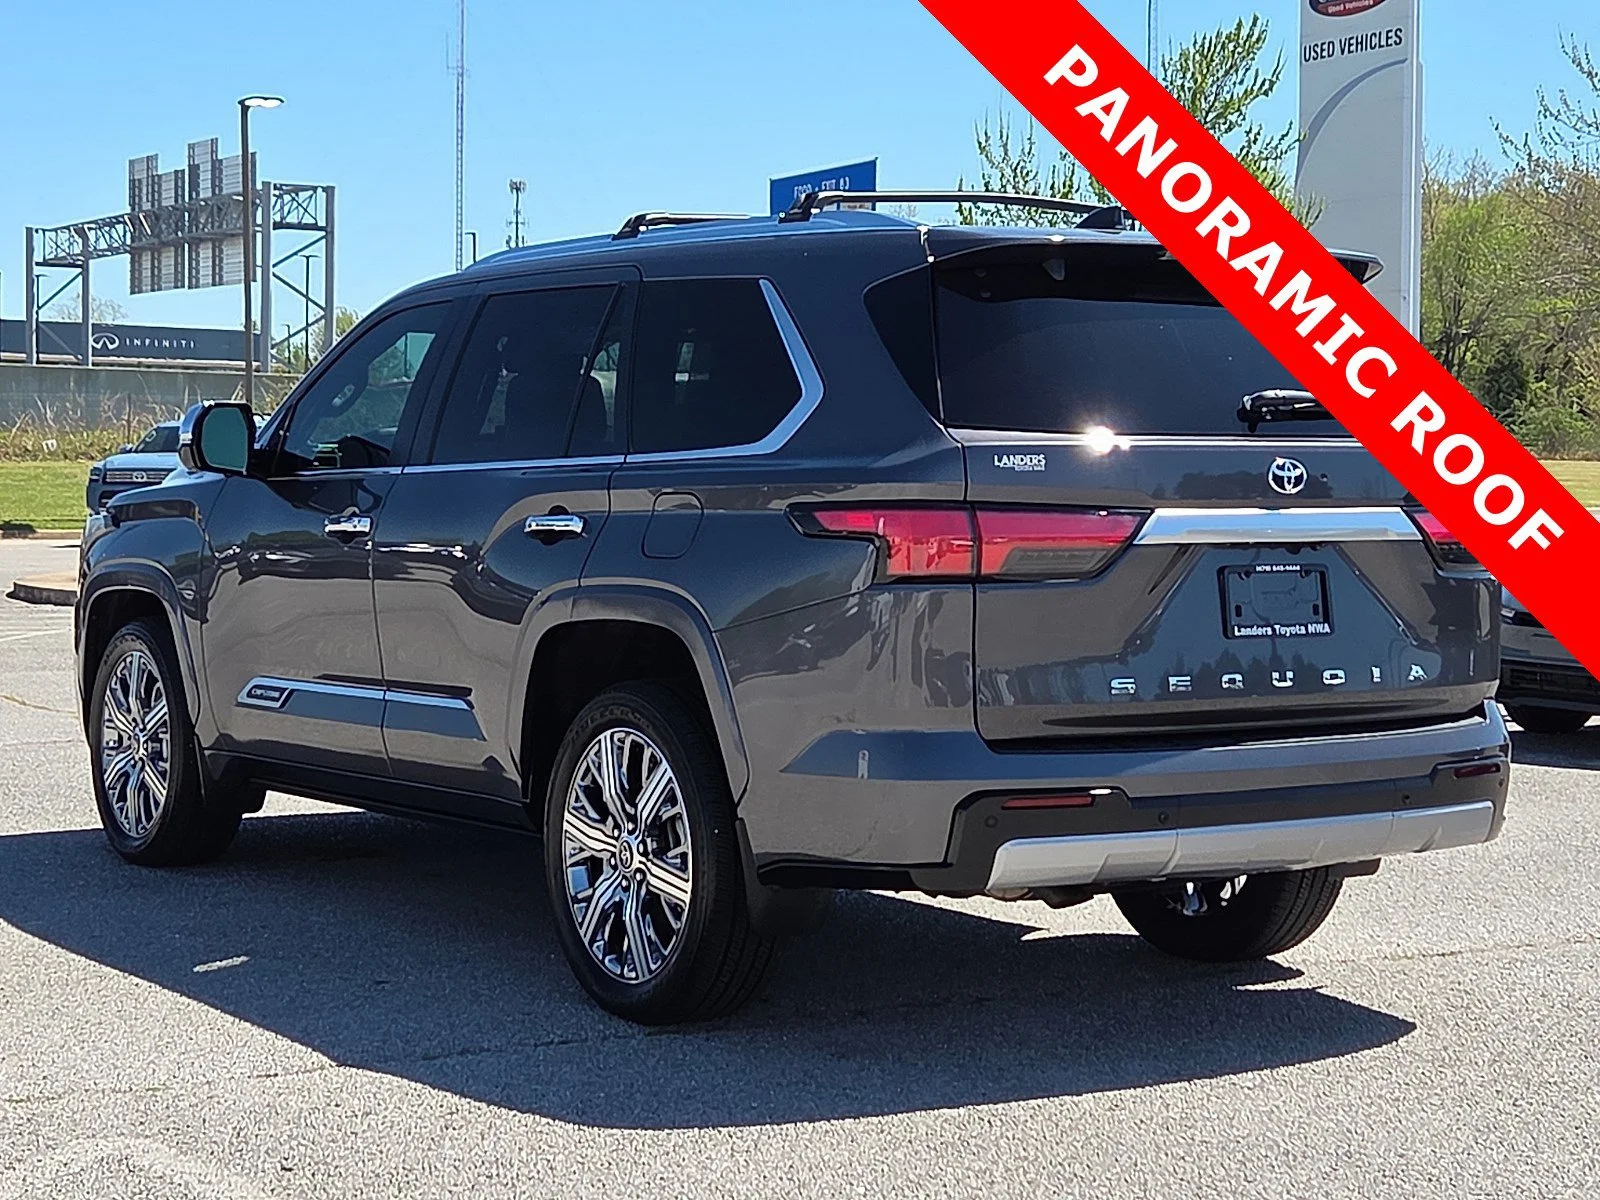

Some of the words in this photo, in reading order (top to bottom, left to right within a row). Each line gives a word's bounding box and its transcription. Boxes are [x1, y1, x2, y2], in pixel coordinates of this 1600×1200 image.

[1303, 40, 1335, 63] USED
[1339, 27, 1403, 56] VEHICLES
[125, 337, 195, 349] INFINITI
[993, 454, 1046, 467] LANDERS
[1234, 625, 1272, 636] Landers
[1273, 624, 1306, 637] Toyota
[1307, 623, 1331, 635] NWA
[1110, 664, 1428, 695] SEQUOIA
